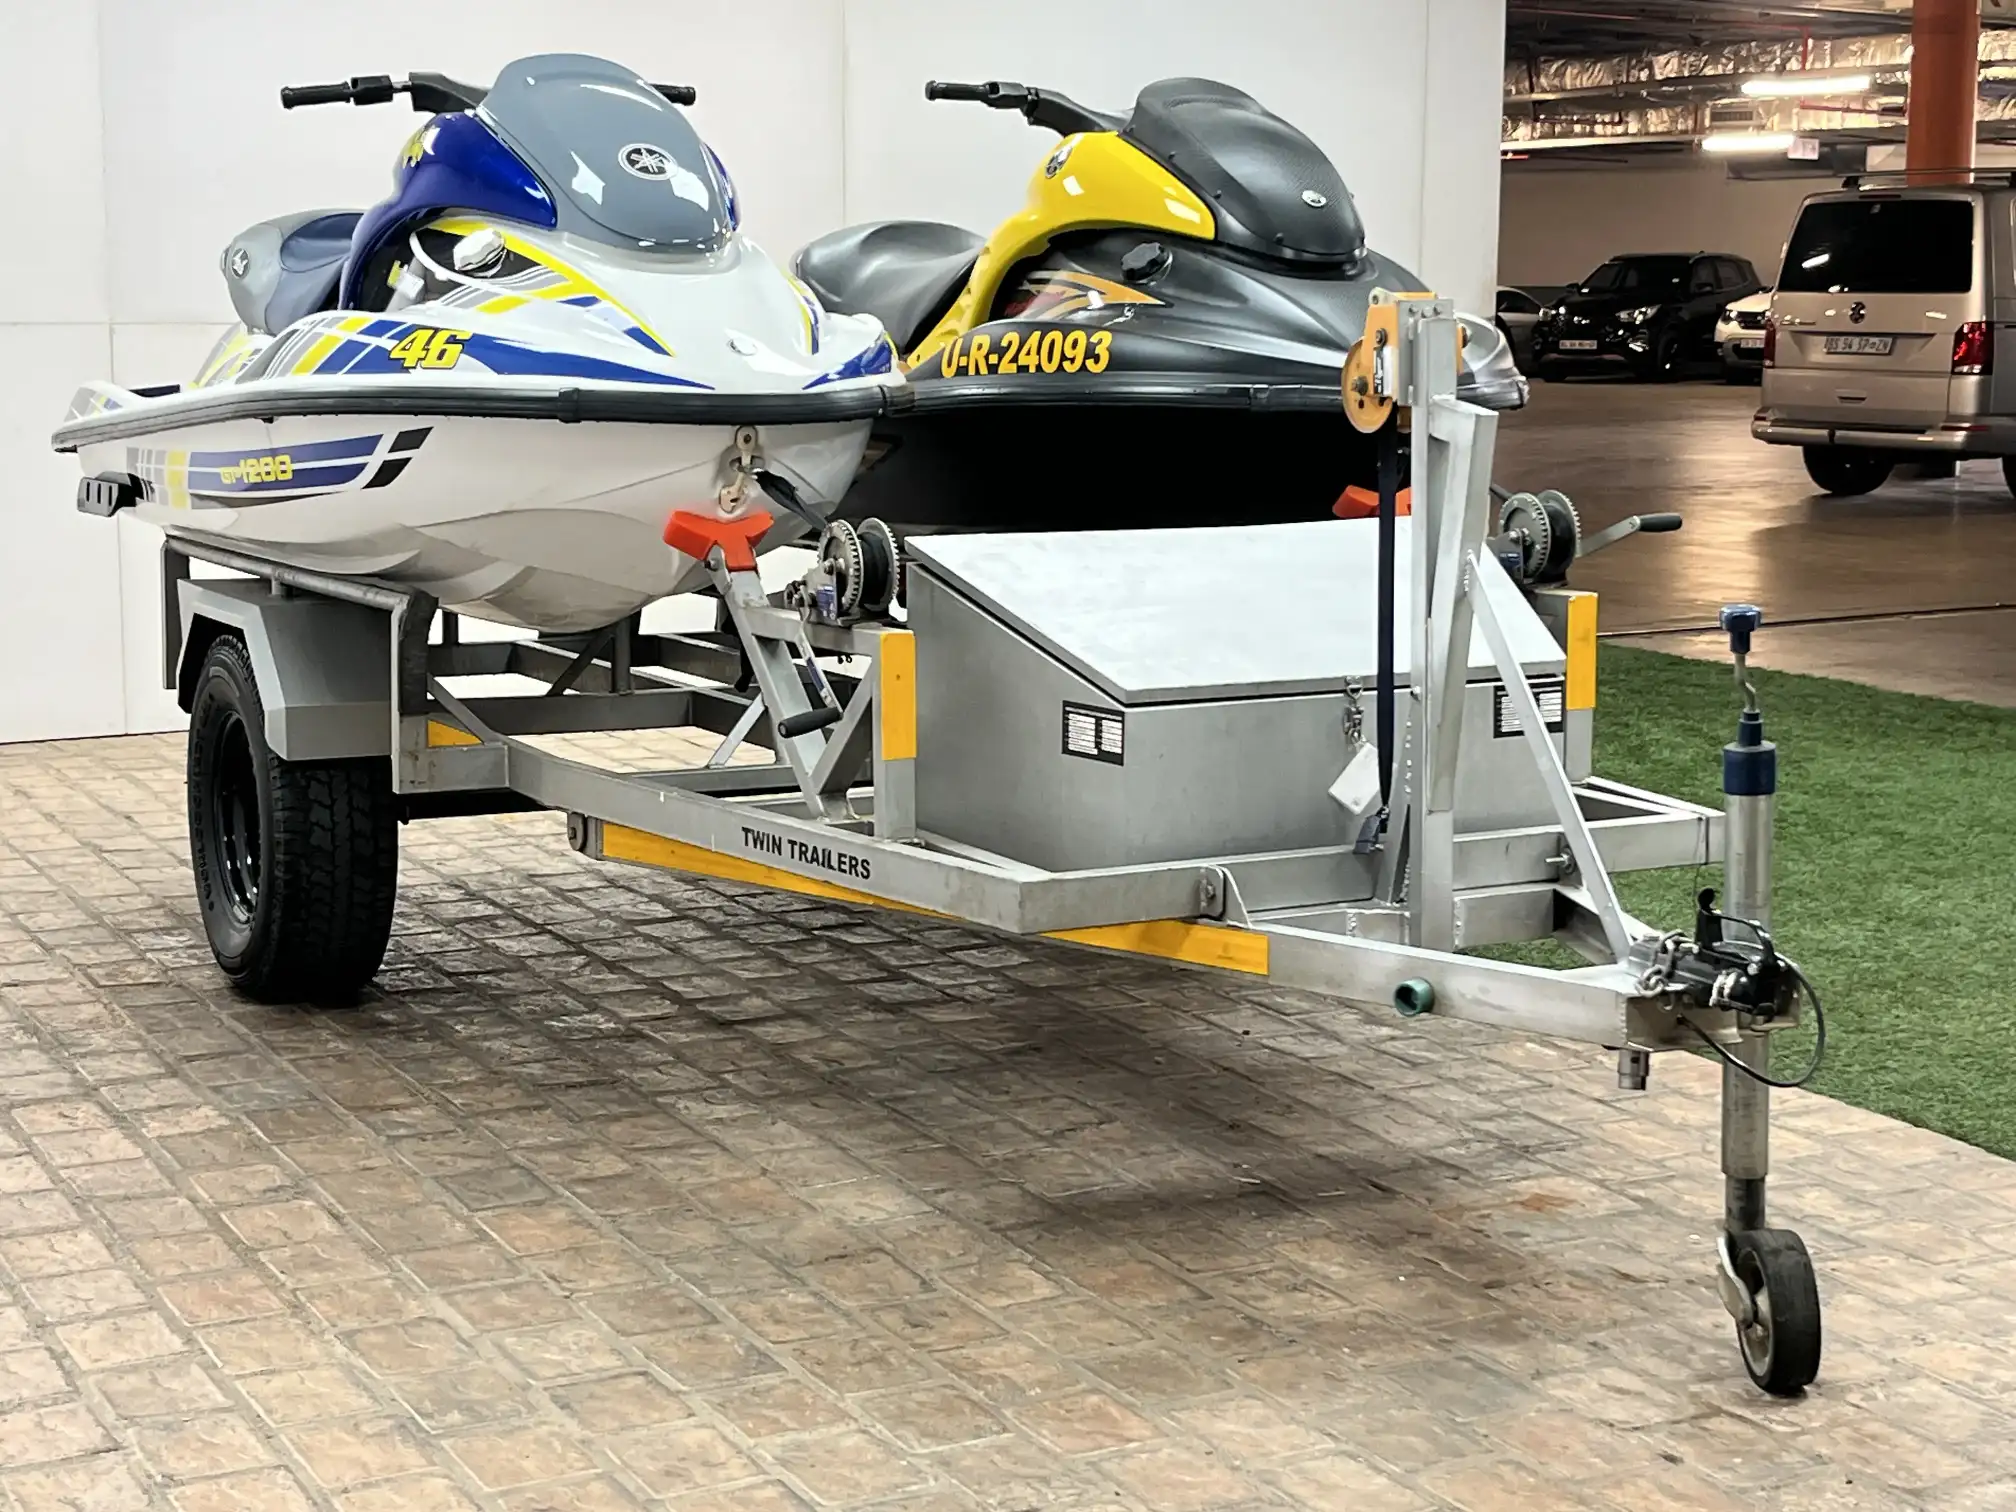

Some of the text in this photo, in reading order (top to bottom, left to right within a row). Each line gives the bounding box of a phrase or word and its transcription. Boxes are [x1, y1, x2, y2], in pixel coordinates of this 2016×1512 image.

[389, 328, 473, 370] 46
[941, 330, 1113, 378] U-R-24093
[741, 826, 871, 880] TWIN TRAILERS
